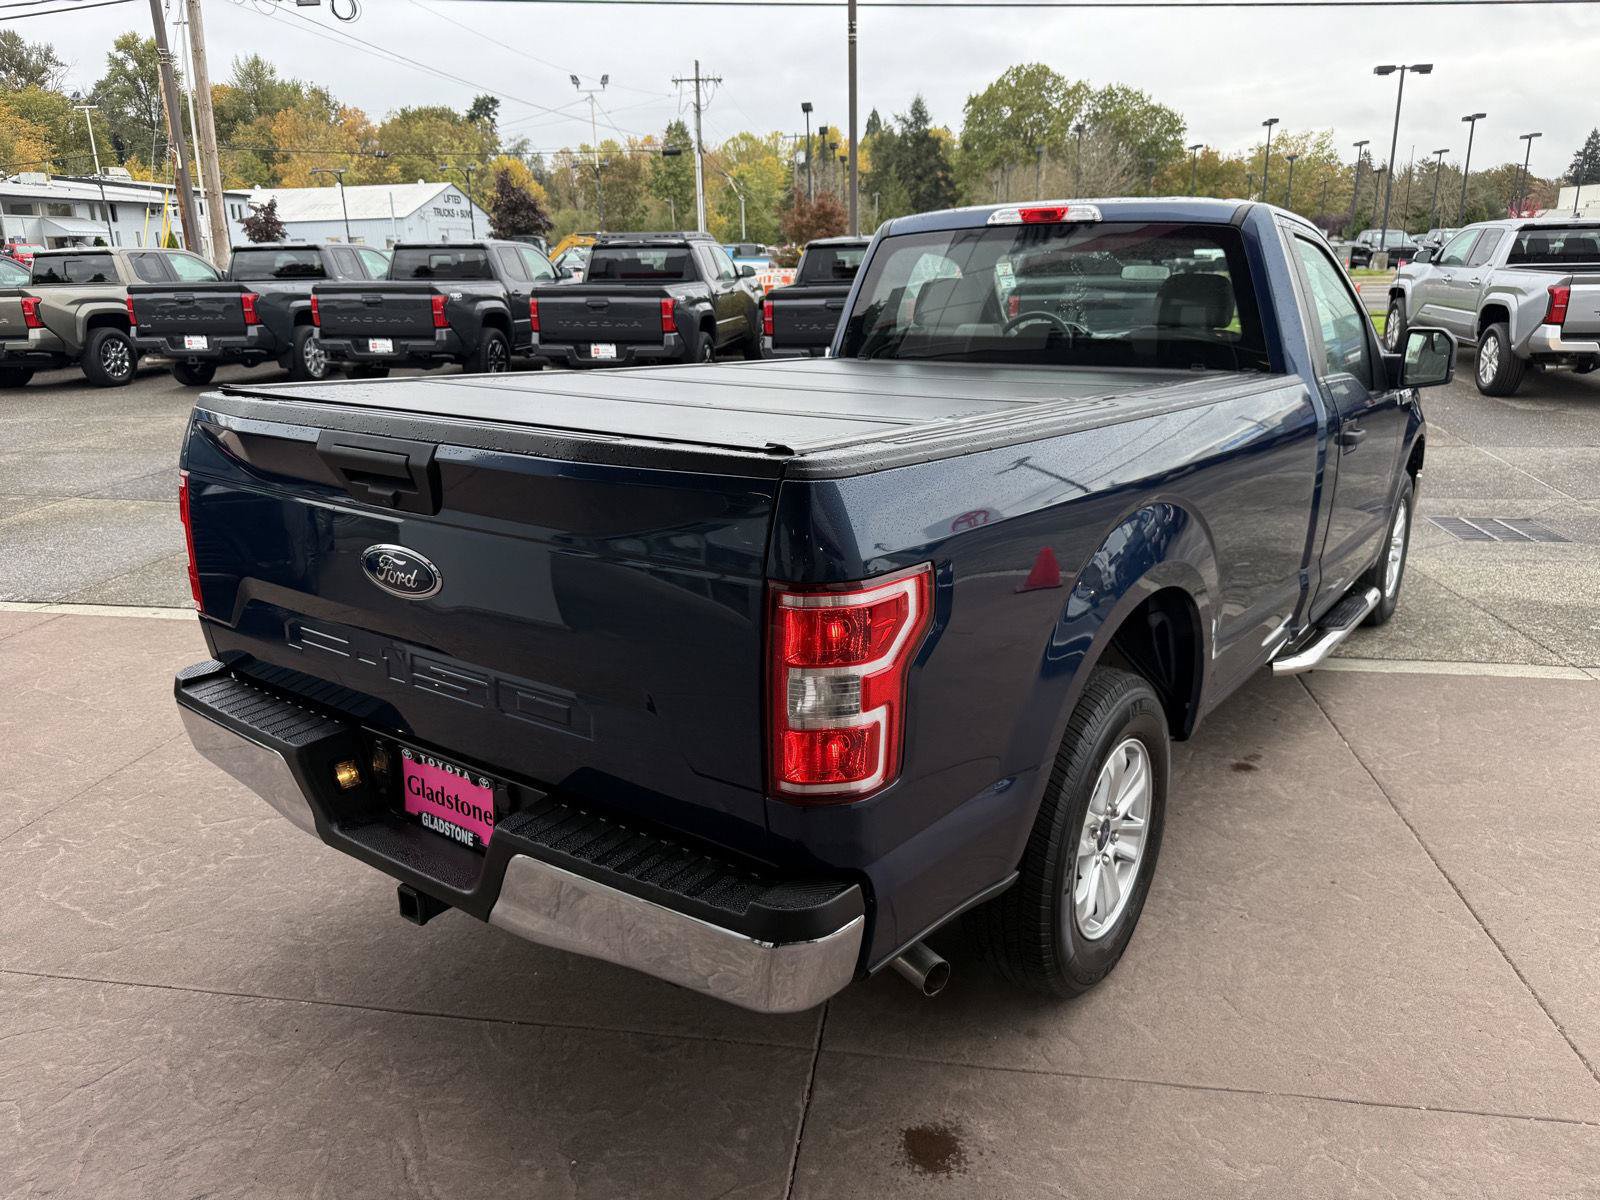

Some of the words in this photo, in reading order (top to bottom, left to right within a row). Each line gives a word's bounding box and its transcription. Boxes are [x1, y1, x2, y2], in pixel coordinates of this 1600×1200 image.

[433, 207, 455, 218] TRUCKS
[558, 320, 643, 328] TACOMA
[375, 554, 419, 589] Ford
[284, 617, 595, 742] F-150
[420, 754, 471, 781] TOYOTA
[407, 774, 494, 828] Gladstone
[422, 812, 475, 848] GLADSTONE
